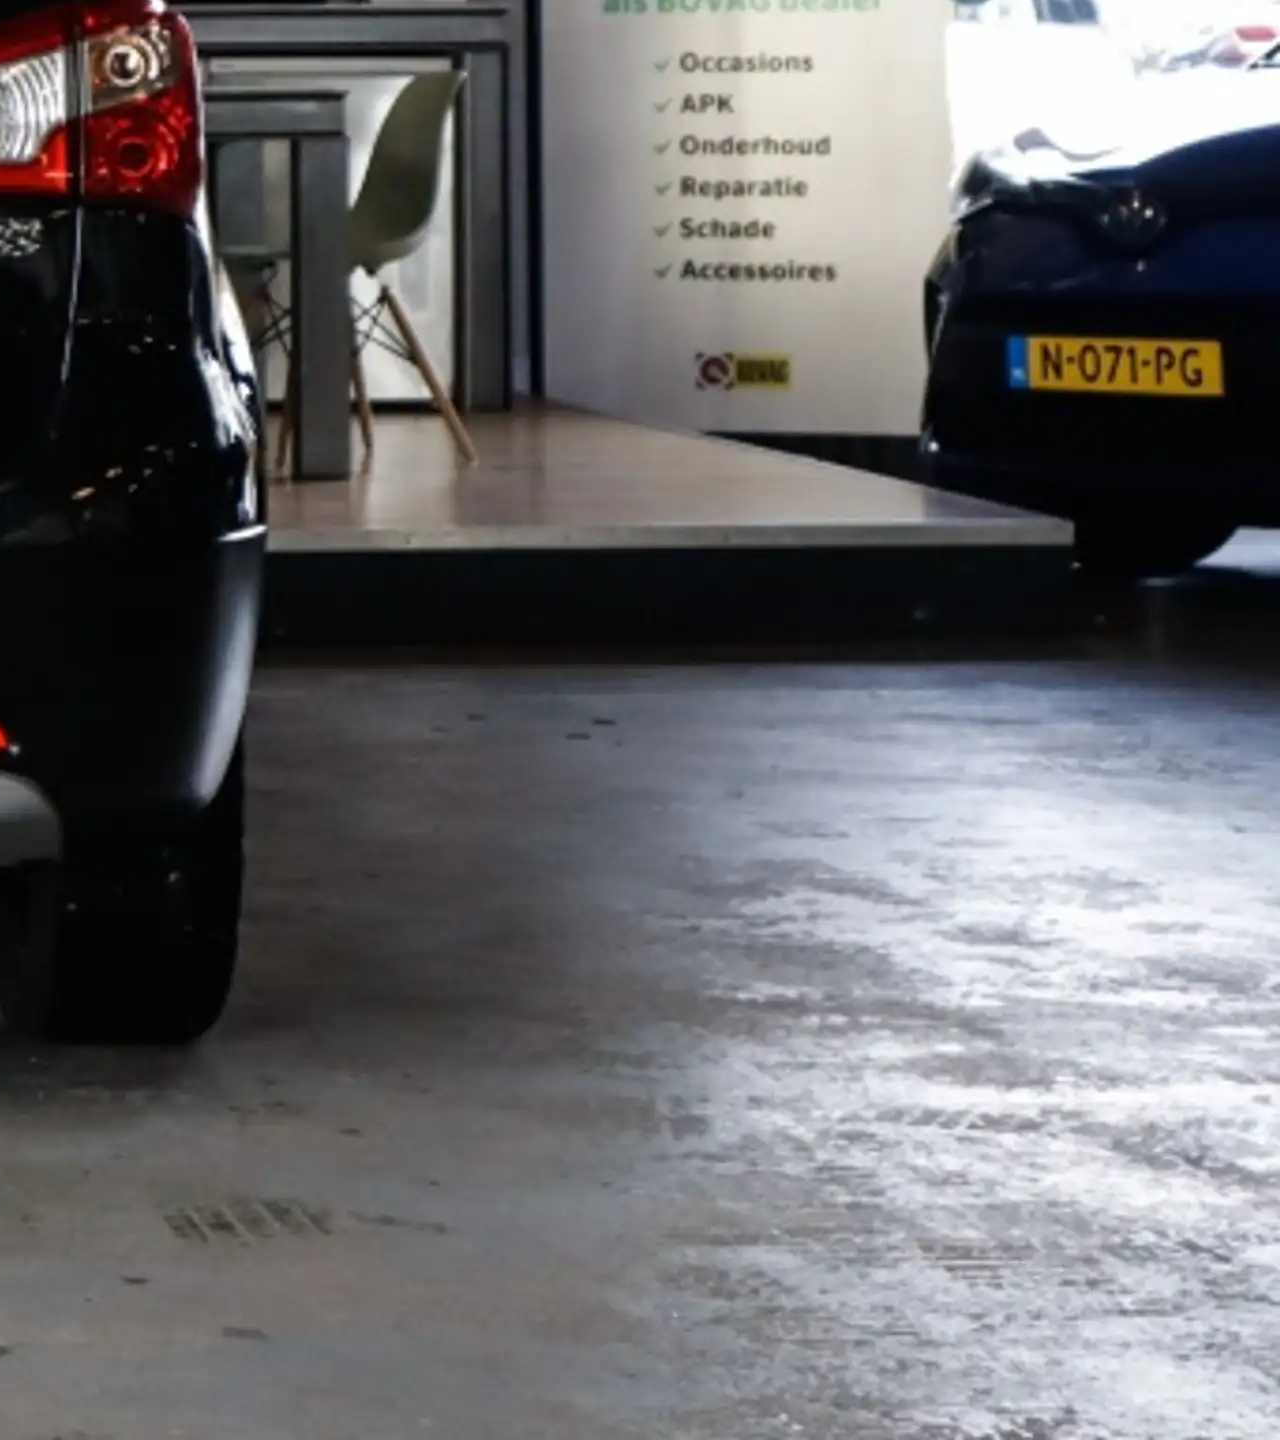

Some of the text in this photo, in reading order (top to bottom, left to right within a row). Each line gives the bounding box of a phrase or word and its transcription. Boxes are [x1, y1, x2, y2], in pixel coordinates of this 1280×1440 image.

[679, 52, 814, 73] Occasions
[679, 94, 735, 114] APK
[679, 135, 832, 156] Onderhoud
[679, 177, 809, 201] Reparatie
[679, 217, 776, 240] Schade
[679, 259, 838, 282] Accessoires
[1041, 342, 1204, 388] N-071-PG
